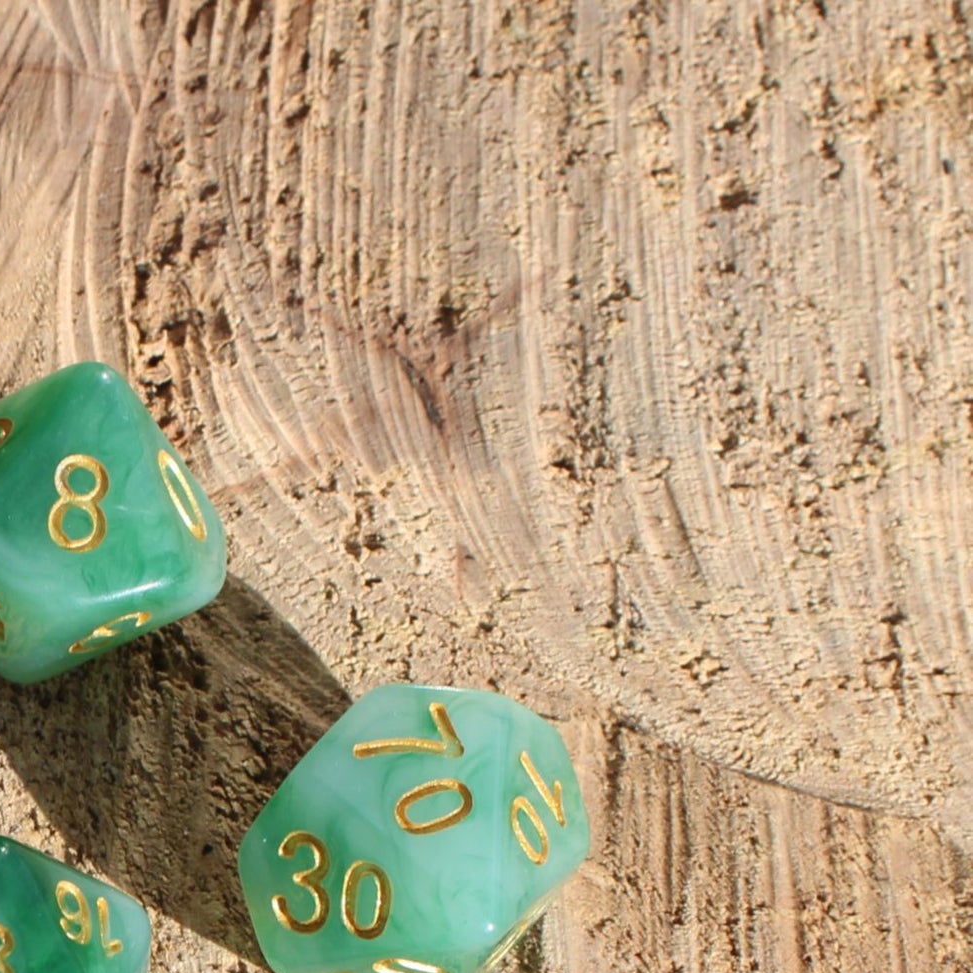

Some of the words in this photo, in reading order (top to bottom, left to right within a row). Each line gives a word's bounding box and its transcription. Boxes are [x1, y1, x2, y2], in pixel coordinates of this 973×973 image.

[48, 454, 109, 552] 8
[158, 449, 207, 542] 0
[272, 831, 392, 940] 30
